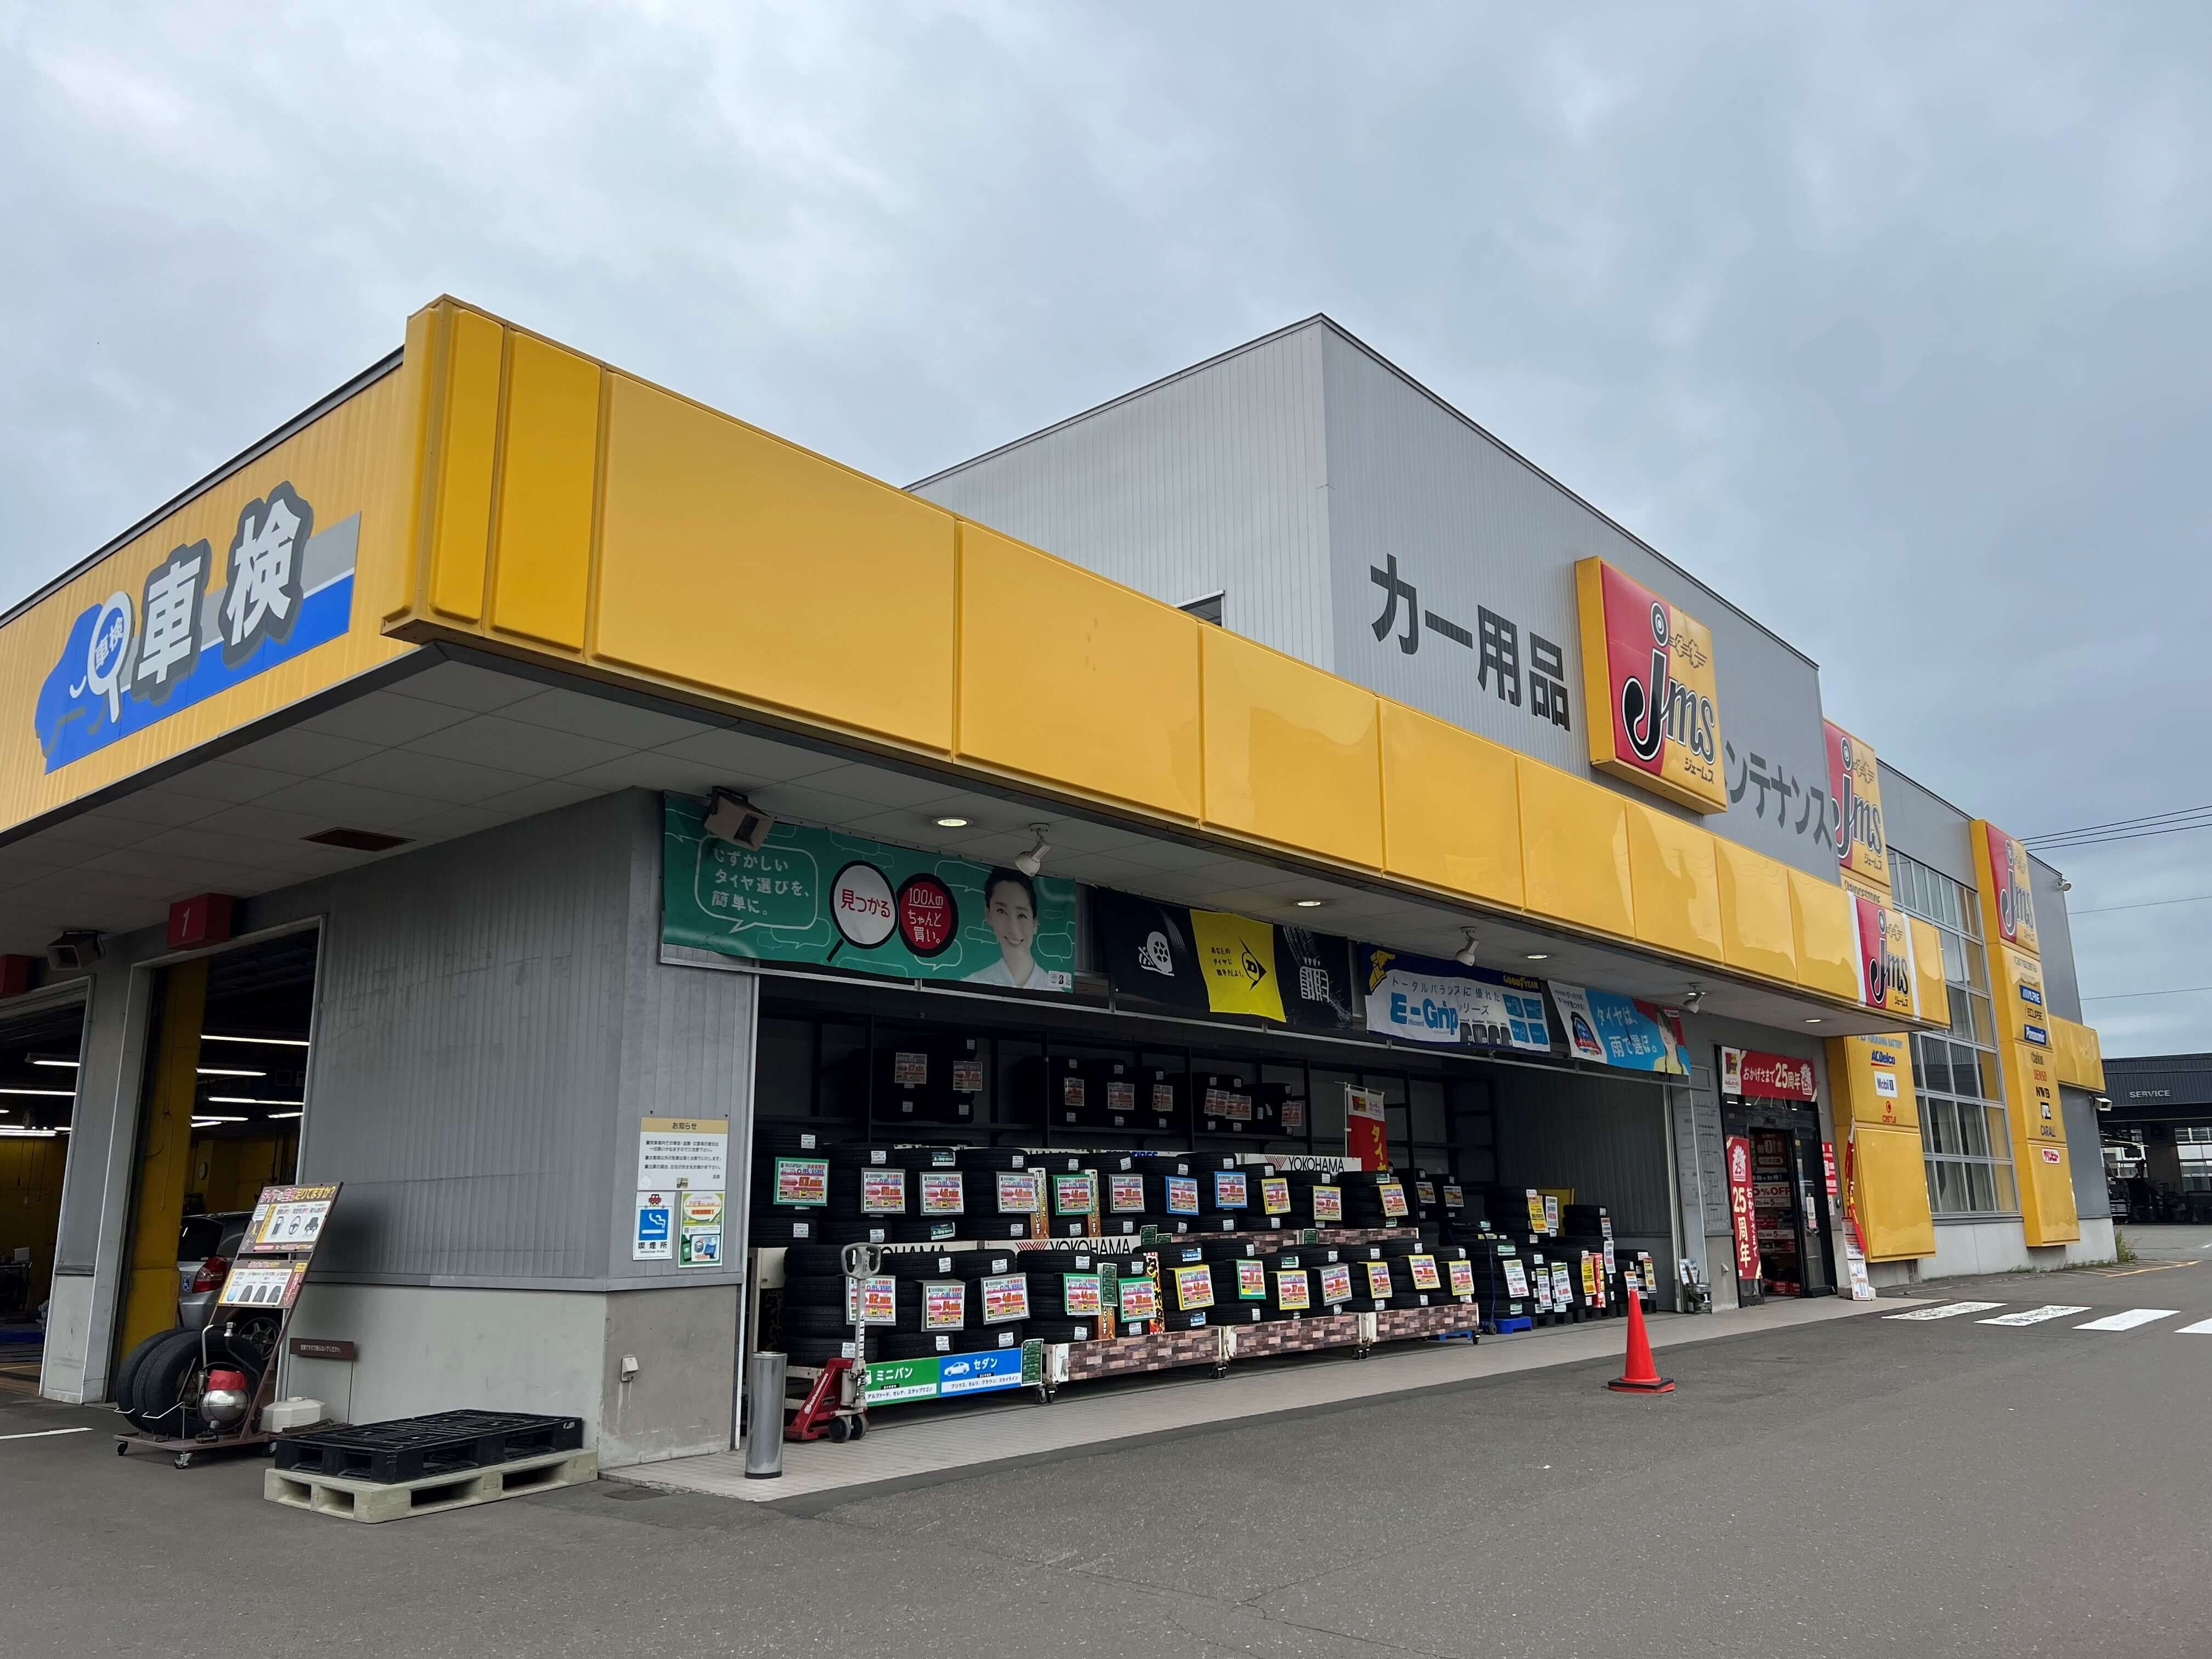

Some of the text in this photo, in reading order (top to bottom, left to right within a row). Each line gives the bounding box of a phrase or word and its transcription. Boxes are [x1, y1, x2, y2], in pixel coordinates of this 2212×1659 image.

[137, 498, 301, 684] 車検
[94, 616, 124, 668] 車検
[1370, 553, 1571, 731] カー用品
[1622, 601, 1716, 764] jms
[1685, 757, 1714, 785] ジェームス
[713, 848, 789, 871] むずかしい
[715, 870, 809, 898] タイヤ選びを、
[712, 889, 769, 917] 簡単に。
[842, 888, 891, 918] 見つかる
[909, 887, 943, 906] 100人の
[182, 907, 190, 937] 1
[909, 910, 942, 927] ちゃんと
[913, 926, 941, 944] 買い。
[1870, 909, 1908, 1004] jms
[1503, 975, 1539, 989] GOODYEAR
[2026, 1026, 2045, 1043] Panasonic
[1871, 1049, 1895, 1065] ACDelco
[2034, 1069, 2047, 1081] DENSO
[2036, 1086, 2050, 1098] NWB
[2129, 1090, 2171, 1098] SERVICE
[673, 1122, 697, 1130] お知らせ
[1289, 1156, 1344, 1172] YOKOHAMA
[638, 1242, 667, 1250] 喫煙所
[973, 1358, 997, 1370] セダン
[877, 1367, 913, 1381] ミニバン
